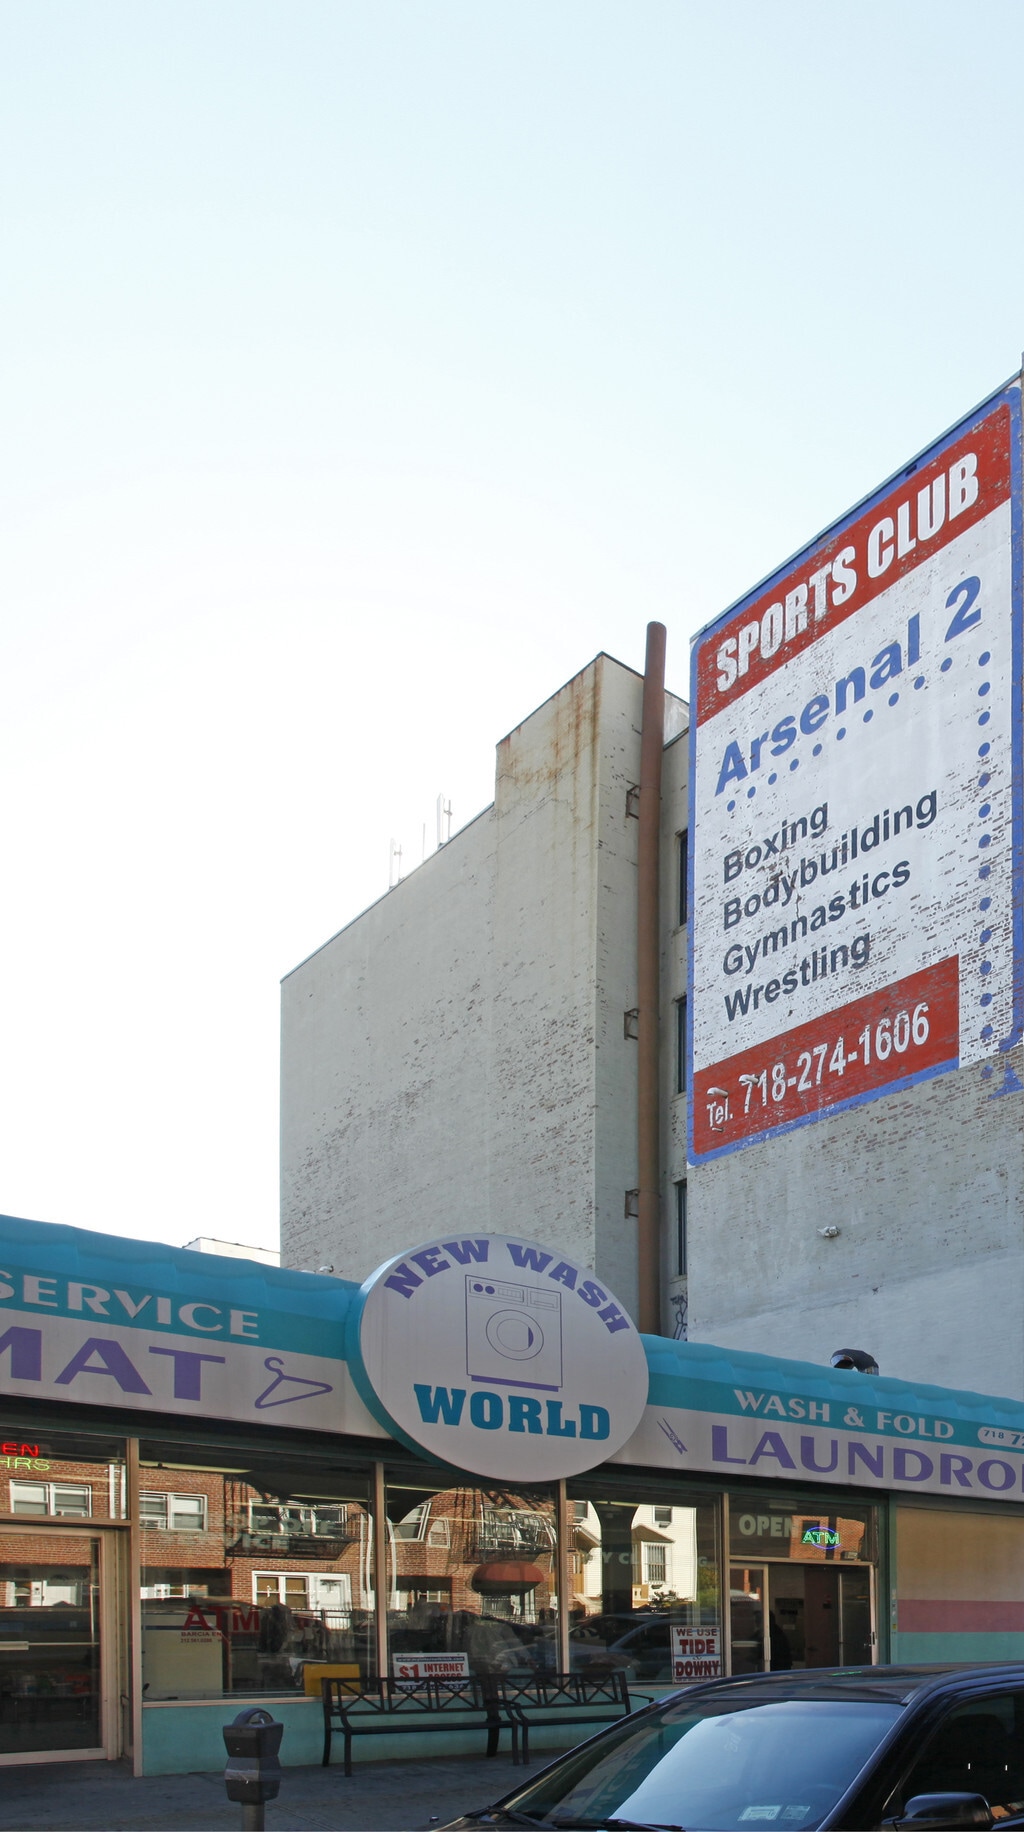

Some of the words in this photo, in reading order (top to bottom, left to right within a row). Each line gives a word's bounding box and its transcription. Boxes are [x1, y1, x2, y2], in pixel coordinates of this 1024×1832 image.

[716, 546, 857, 692] SPORTS
[868, 453, 979, 578] CLUB
[715, 612, 920, 797] Arsenal
[945, 575, 982, 642] 2
[723, 803, 829, 884] Boxing
[723, 790, 937, 930] Bodybuilding
[723, 859, 911, 977] Gymnastics
[724, 933, 871, 1021] Wrestling
[707, 1096, 733, 1127] Tel.
[740, 1002, 929, 1113] 718-274-1606
[384, 1240, 490, 1299] NEW
[506, 1243, 630, 1334] WASH
[413, 1384, 610, 1441] WORLD
[733, 1389, 830, 1422] WASH
[843, 1407, 865, 1427] &
[877, 1411, 954, 1439] FOLD
[984, 1429, 1005, 1439] 718
[802, 1531, 840, 1545] ATM
[182, 1603, 260, 1631] ATM
[676, 1628, 693, 1636] WE
[696, 1628, 718, 1636] USE
[423, 1662, 465, 1673] INTERNET
[675, 1660, 720, 1677] DOWNY
[679, 1638, 716, 1655] TIDE
